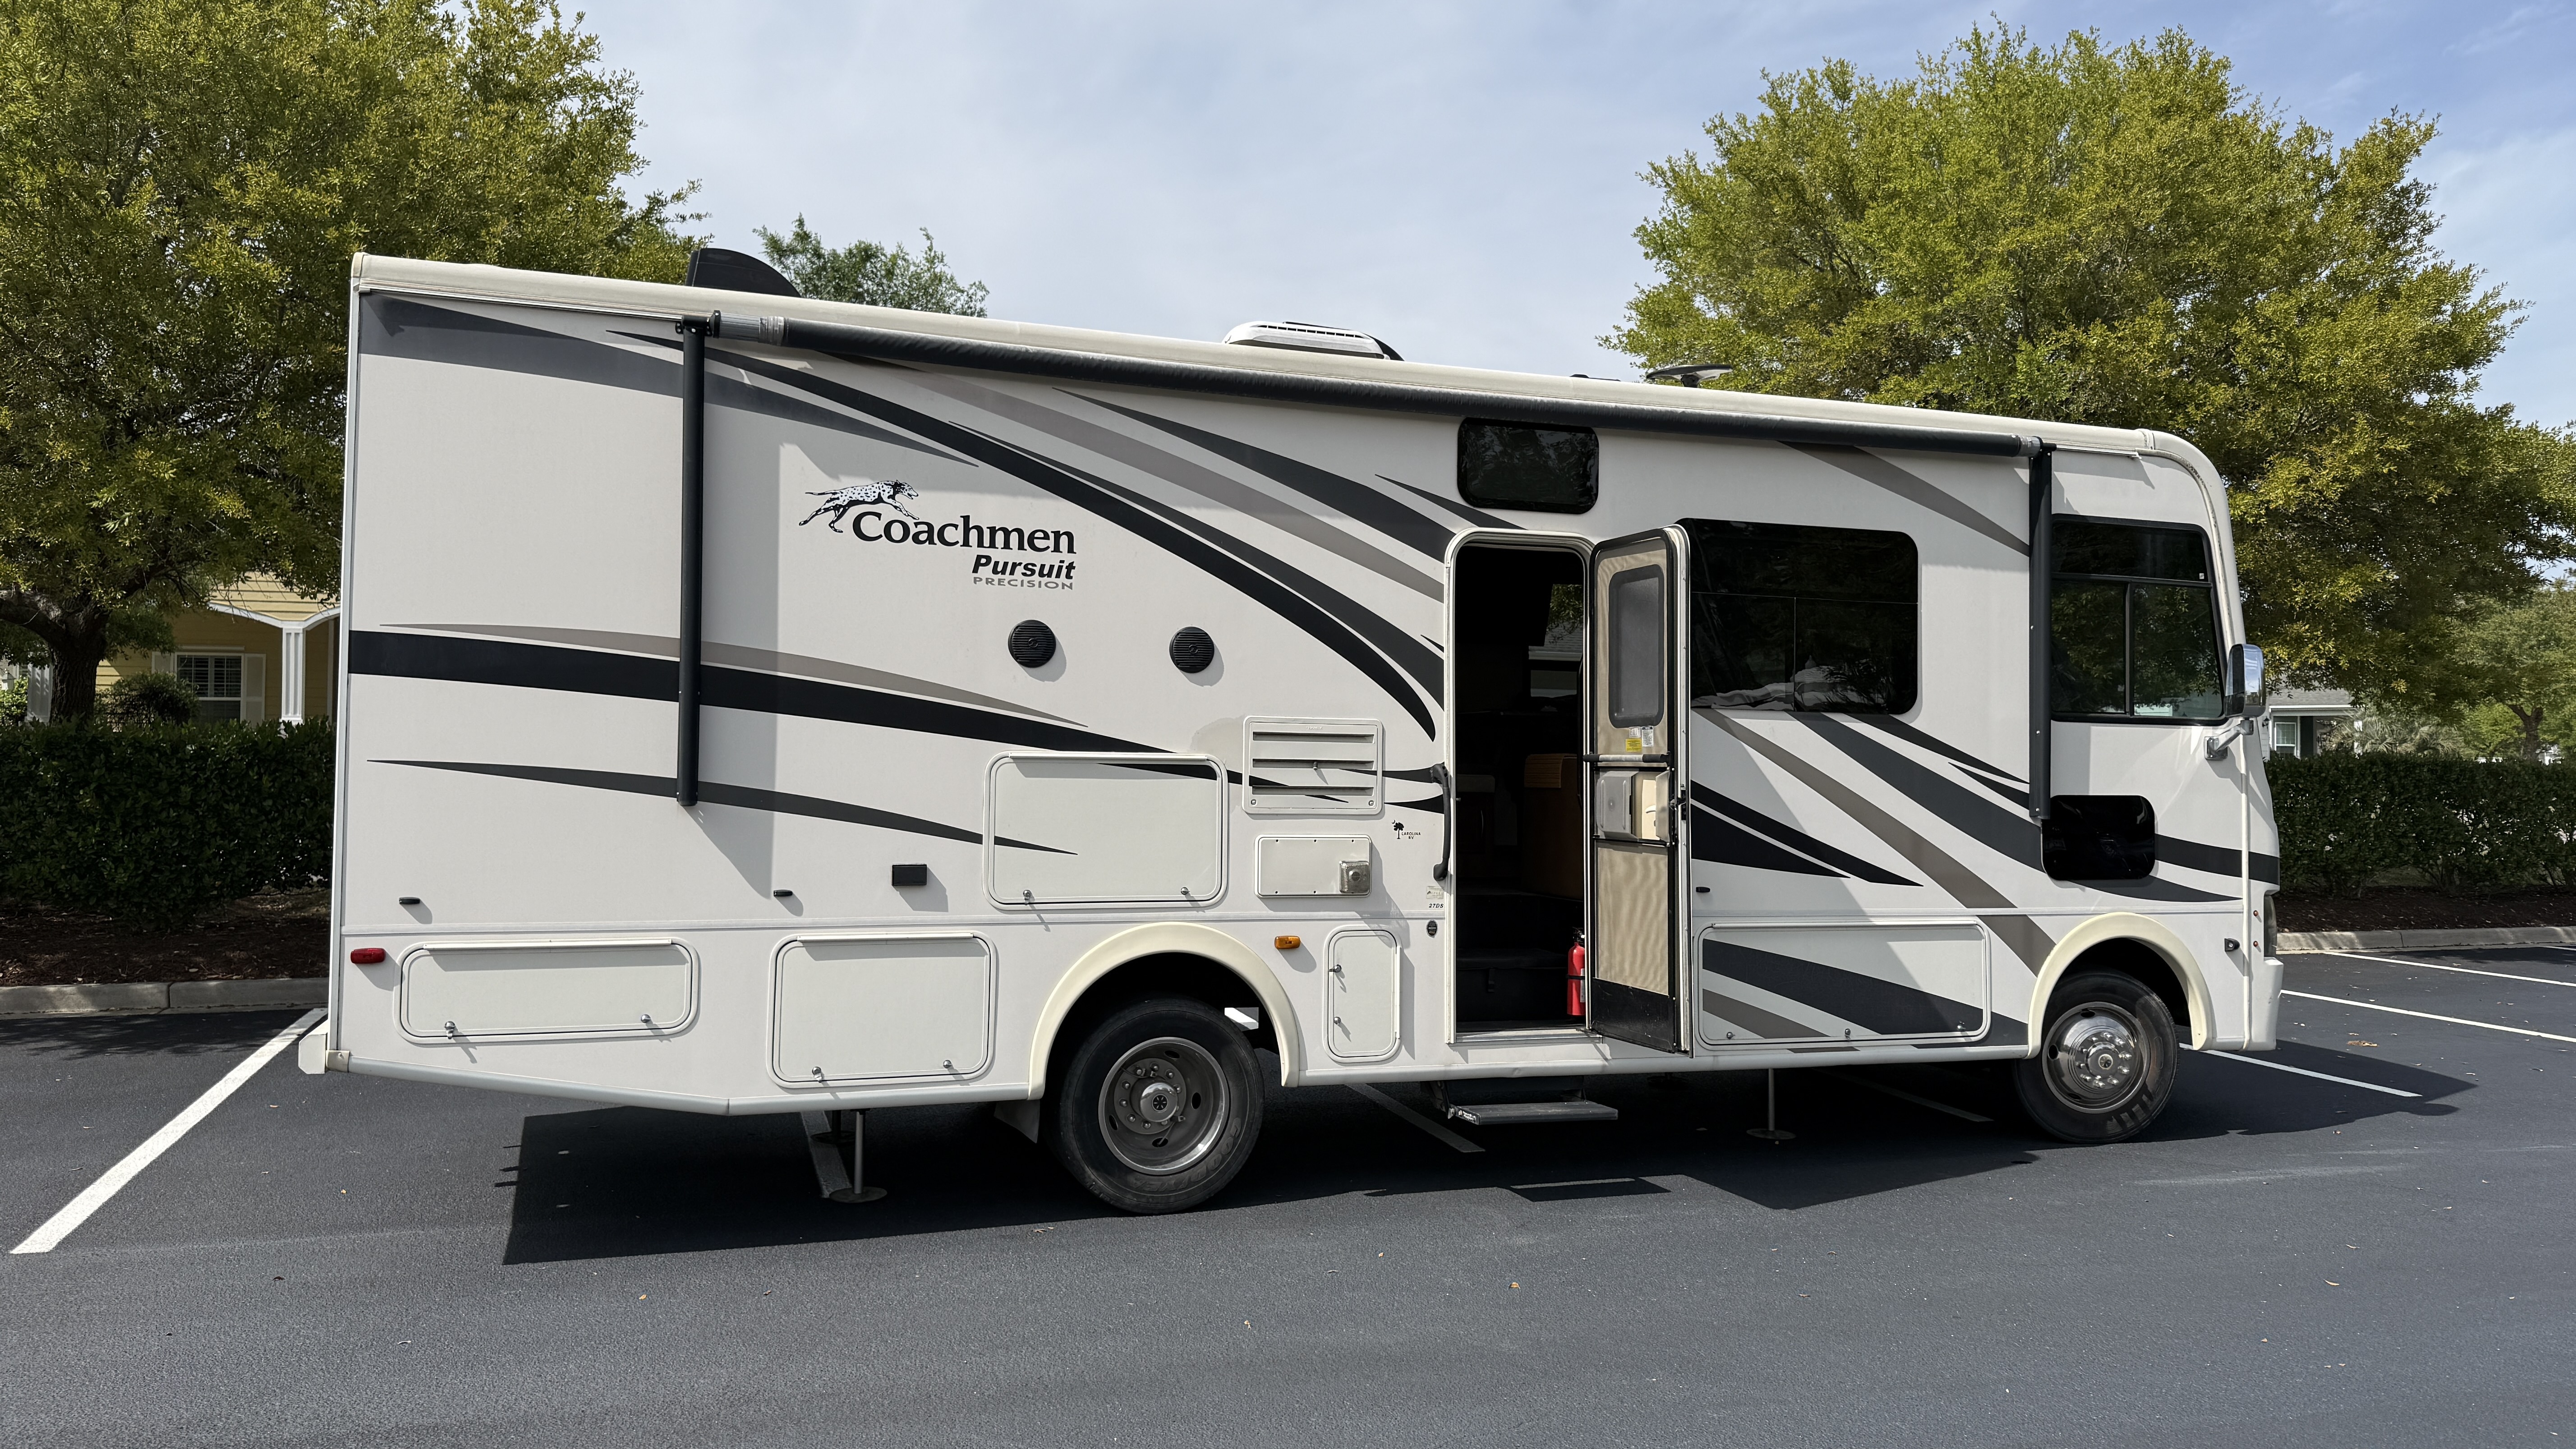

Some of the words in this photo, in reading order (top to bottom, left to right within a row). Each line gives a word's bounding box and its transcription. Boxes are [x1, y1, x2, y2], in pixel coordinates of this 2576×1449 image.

[852, 511, 1076, 554] Coachmen
[972, 554, 1076, 580] Pursuit
[973, 576, 1073, 590] PRECISION
[1124, 1117, 1242, 1191] GOODYEA
